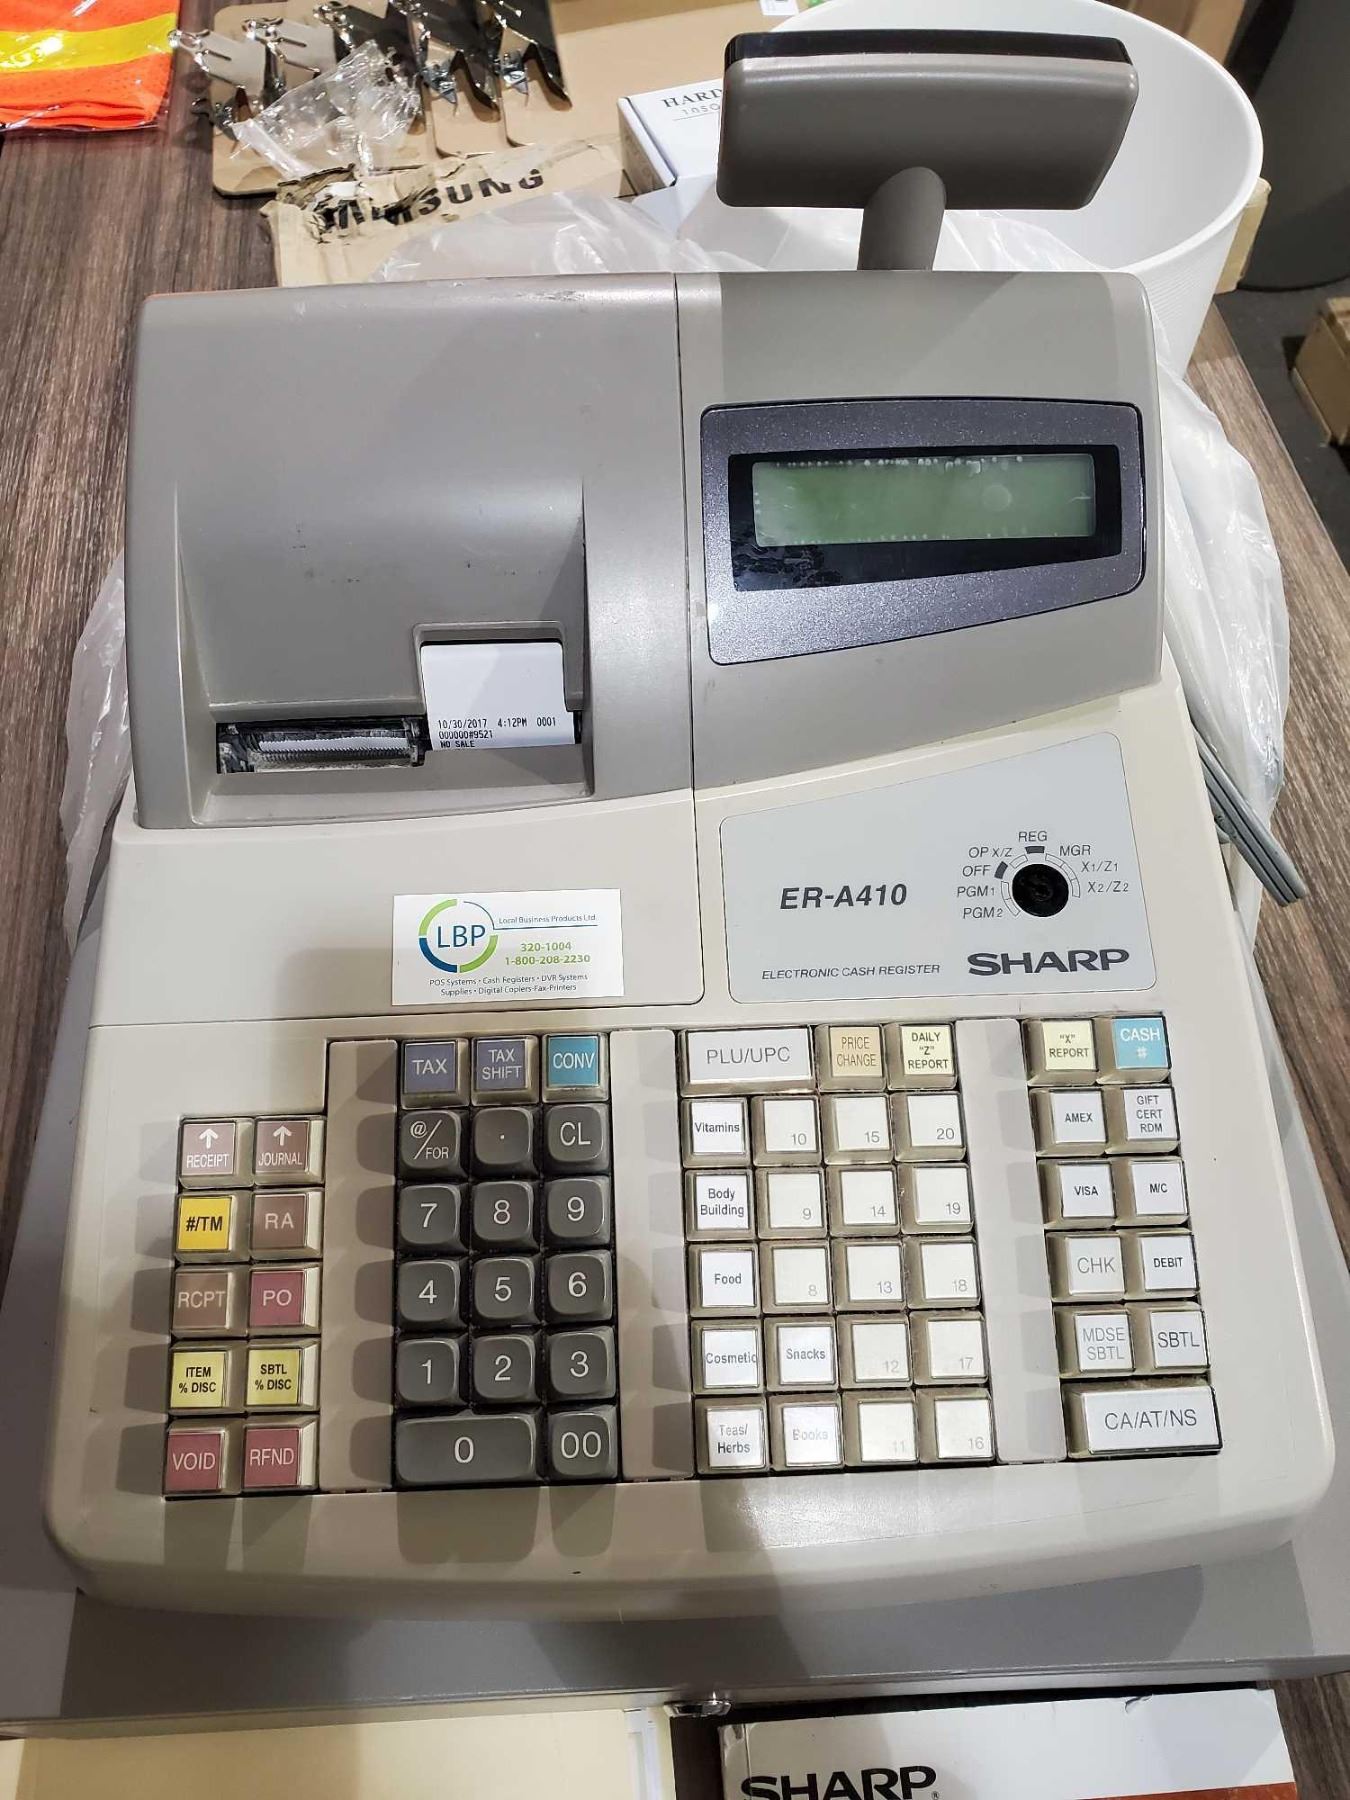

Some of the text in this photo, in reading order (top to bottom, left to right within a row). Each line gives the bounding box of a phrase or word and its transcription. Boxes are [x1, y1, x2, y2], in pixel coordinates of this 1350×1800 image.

[660, 88, 722, 108] HARD
[438, 716, 556, 729] 10/30/2017 4:12PM 0001
[440, 740, 475, 748] NO SALE
[1018, 831, 1048, 843] REG
[968, 846, 1013, 858] OP X/Z
[1059, 844, 1091, 856] MGR
[962, 865, 991, 877] OFF
[1081, 861, 1118, 872] X1/Z1
[1087, 880, 1129, 893] X2/Z2
[779, 883, 907, 910] ER-A410
[499, 916, 518, 924] Local
[518, 915, 550, 923] Business
[551, 914, 582, 923] Products
[438, 924, 486, 948] LBP
[521, 942, 572, 952] 320-1004
[505, 954, 590, 965] 1-800-208-2230
[967, 949, 1130, 976] SHARP
[762, 964, 940, 980] ELECTRONIC CASH REGISTER
[446, 978, 477, 987] Systems
[482, 976, 500, 985] Cash
[502, 975, 535, 985] Registers
[541, 974, 557, 982] DVR
[558, 974, 588, 982] Systems
[441, 988, 472, 997] Supplies
[478, 986, 503, 996] Digital
[911, 1031, 941, 1042] DAILY
[1119, 1028, 1161, 1042] CASH
[841, 1036, 870, 1050] PRICE
[488, 1048, 515, 1062] TAX
[706, 1046, 791, 1065] PLU/UPC
[1049, 1047, 1090, 1058] REPORT
[412, 1058, 447, 1075] TAX
[553, 1052, 595, 1069] CONV
[836, 1053, 877, 1067] CHANGE
[907, 1058, 949, 1069] REPORT
[482, 1065, 522, 1080] SHIFT
[1136, 1095, 1159, 1105] GIFT
[1064, 1112, 1093, 1123] AMEX
[1136, 1109, 1163, 1119] CERT
[560, 1121, 591, 1146] CL
[695, 1122, 740, 1133] Vitamins
[936, 1127, 955, 1140] 20
[1140, 1123, 1163, 1133] RDM
[791, 1133, 807, 1146] 10
[865, 1130, 880, 1144] 15
[186, 1153, 230, 1168] RECEIPT
[258, 1152, 303, 1166] JOURNAL
[708, 1188, 735, 1201] Body
[1074, 1186, 1099, 1196] VISA
[1150, 1183, 1168, 1193] M/C
[493, 1199, 511, 1224] 8
[567, 1196, 585, 1221] 9
[700, 1204, 745, 1217] Building
[802, 1207, 812, 1220] 9
[871, 1205, 886, 1217] 14
[945, 1202, 961, 1215] 19
[265, 1212, 294, 1230] RA
[421, 1203, 438, 1228] 7
[1077, 1256, 1116, 1274] CHK
[1153, 1257, 1183, 1268] DEBIT
[568, 1271, 587, 1297] 6
[714, 1273, 742, 1285] Food
[951, 1279, 968, 1292] 18
[418, 1279, 437, 1304] 4
[494, 1277, 512, 1301] 5
[808, 1284, 818, 1297] 8
[877, 1281, 893, 1294] 13
[178, 1291, 226, 1308] RCPT
[263, 1289, 292, 1306] PO
[1082, 1327, 1125, 1342] MDSE
[1158, 1331, 1200, 1348] SBTL
[786, 1348, 826, 1360] Snacks
[1087, 1346, 1125, 1361] SBTL
[260, 1363, 287, 1375] SBTL
[494, 1355, 512, 1381] 2
[570, 1351, 589, 1377] 3
[884, 1360, 900, 1373] 12
[958, 1357, 974, 1370] 17
[185, 1366, 212, 1378] ITEM
[421, 1359, 432, 1384] 1
[191, 1381, 217, 1393] DISC
[267, 1379, 292, 1390] DISC
[1105, 1408, 1198, 1430] CA/AT/NS
[719, 1423, 748, 1436] Teas/
[792, 1428, 829, 1441] Books
[454, 1436, 474, 1463] 0
[560, 1431, 602, 1459] 00
[717, 1441, 750, 1454] Herbs
[968, 1437, 985, 1450] 16
[172, 1452, 216, 1470] VOID
[250, 1447, 295, 1467] RFND
